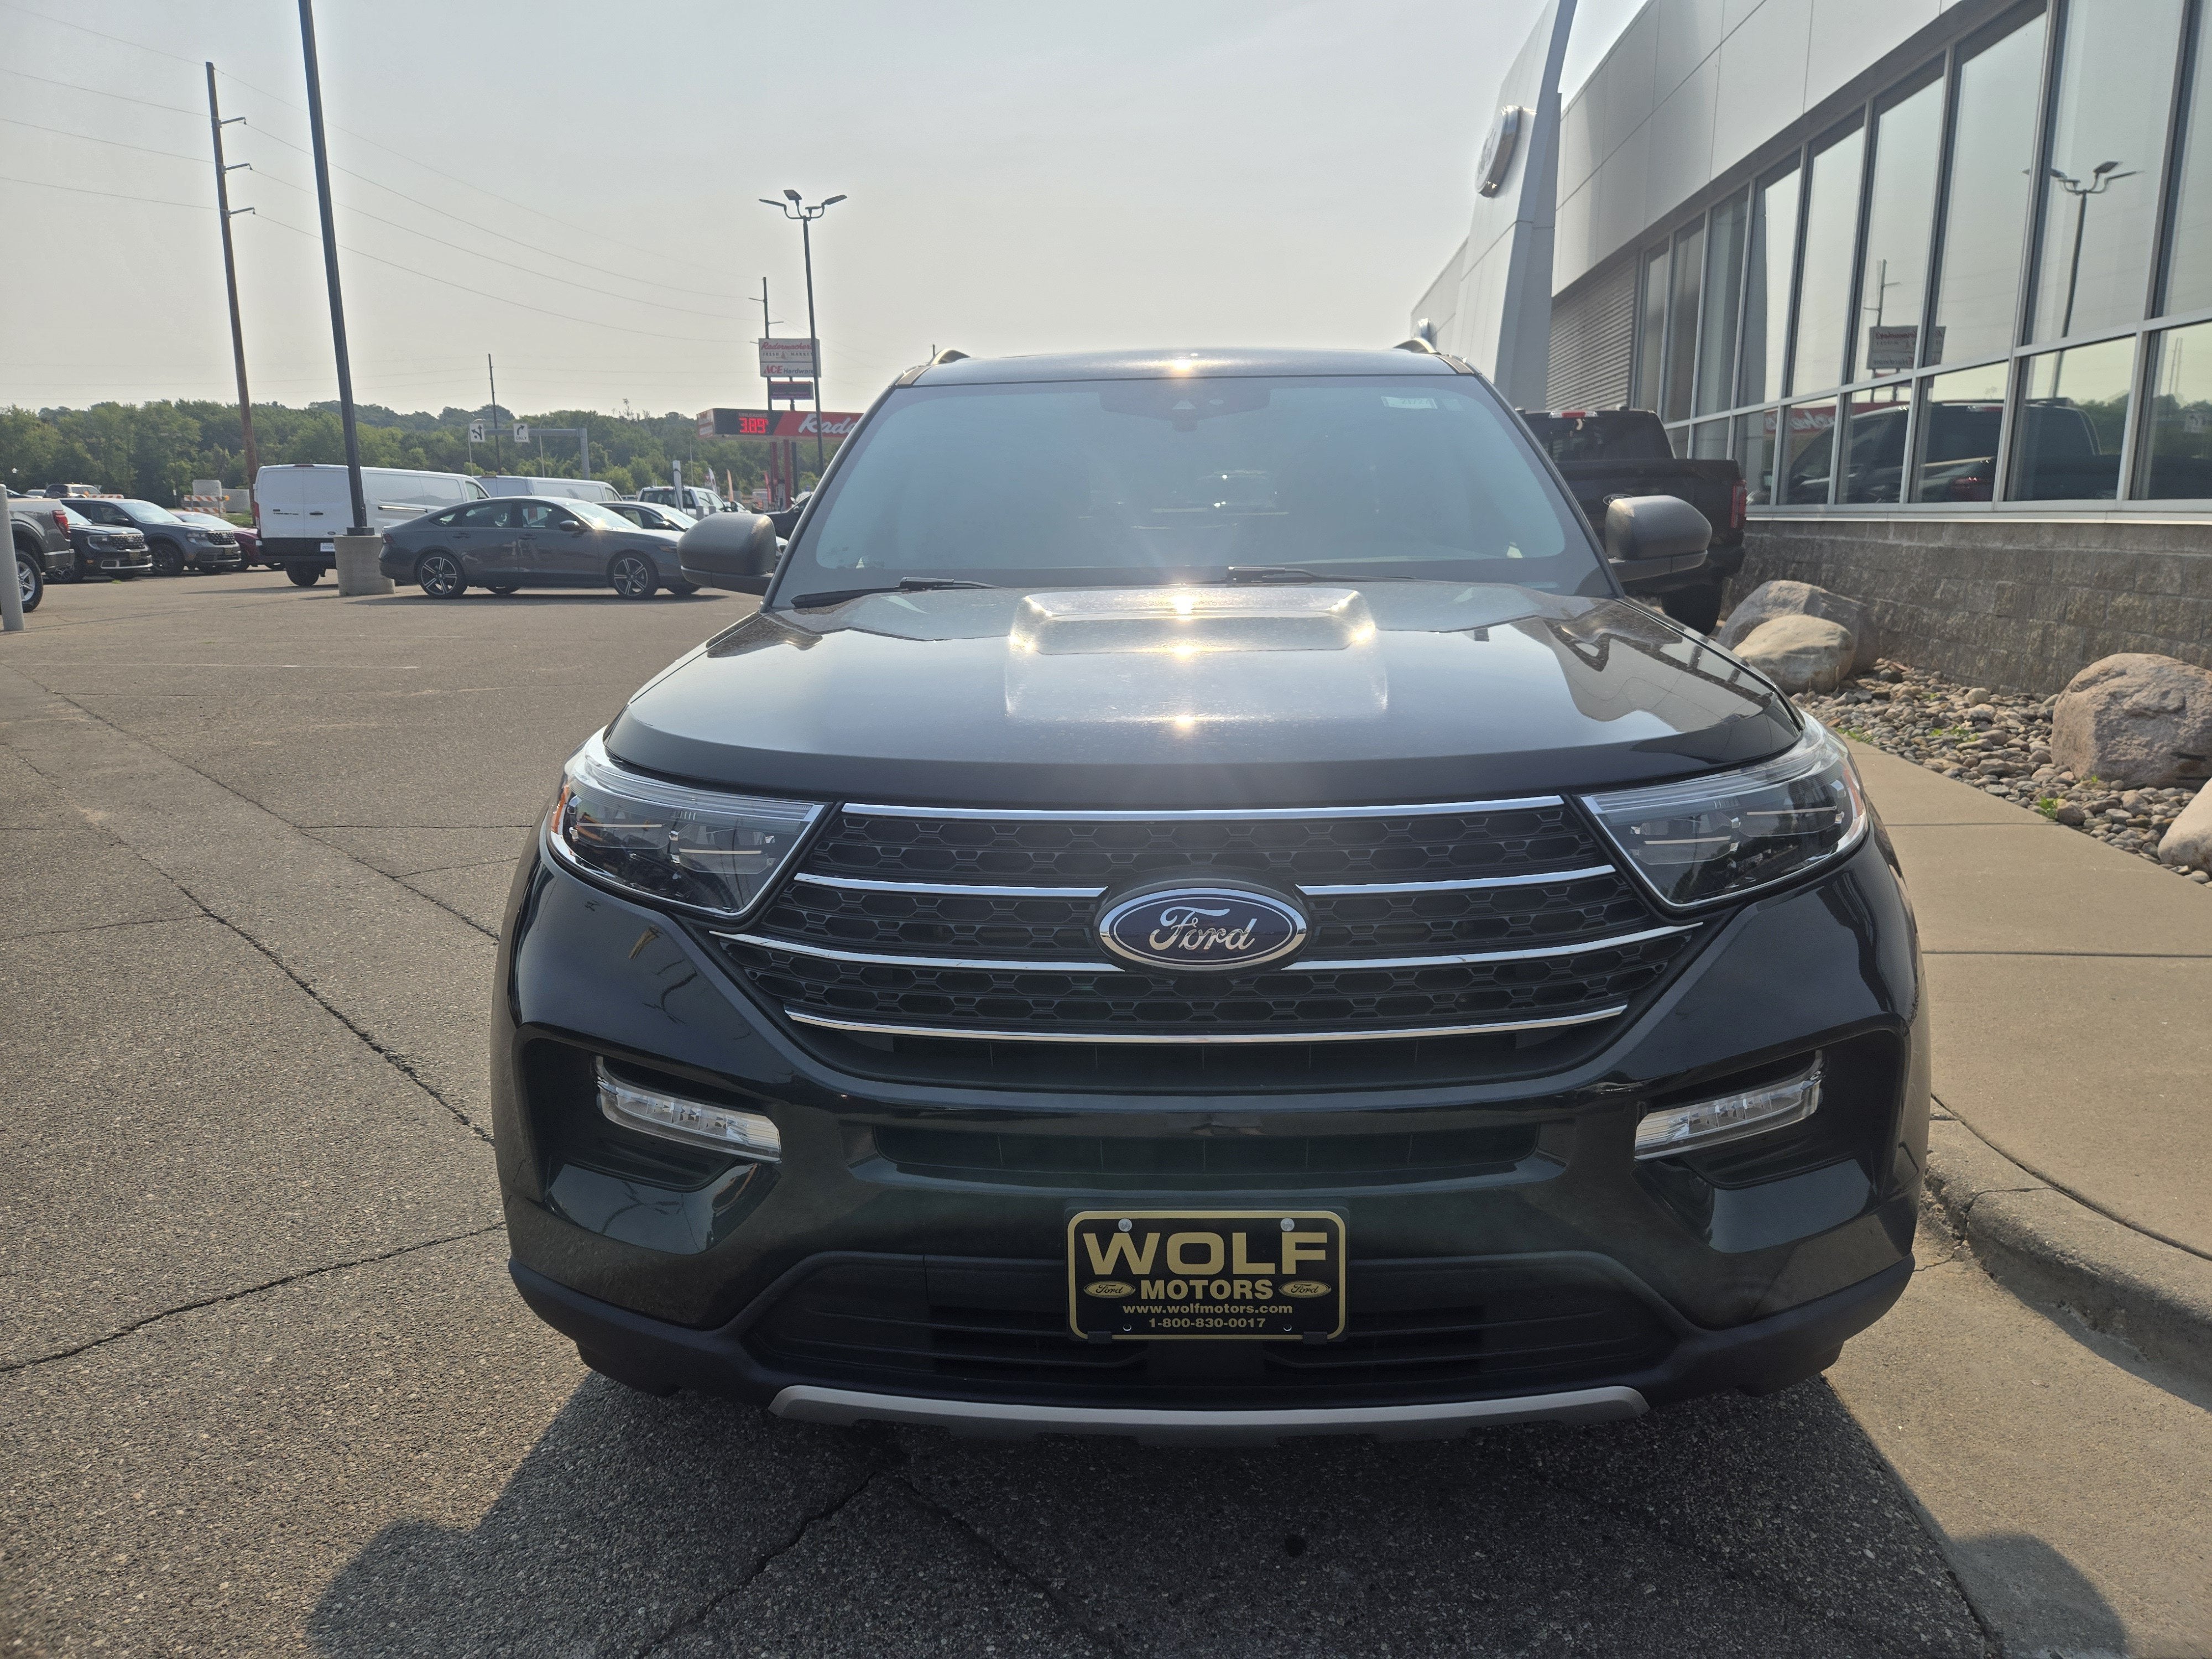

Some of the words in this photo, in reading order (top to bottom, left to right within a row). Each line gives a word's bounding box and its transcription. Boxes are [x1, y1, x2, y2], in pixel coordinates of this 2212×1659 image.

[763, 364, 783, 374] ACE
[1149, 906, 1258, 951] Ford
[1082, 1232, 1327, 1275] WOLF
[1140, 1279, 1273, 1300] MOTORS
[1123, 1303, 1293, 1313] www.wolfmotors.com
[1149, 1318, 1266, 1328] 1-800-830-0017
